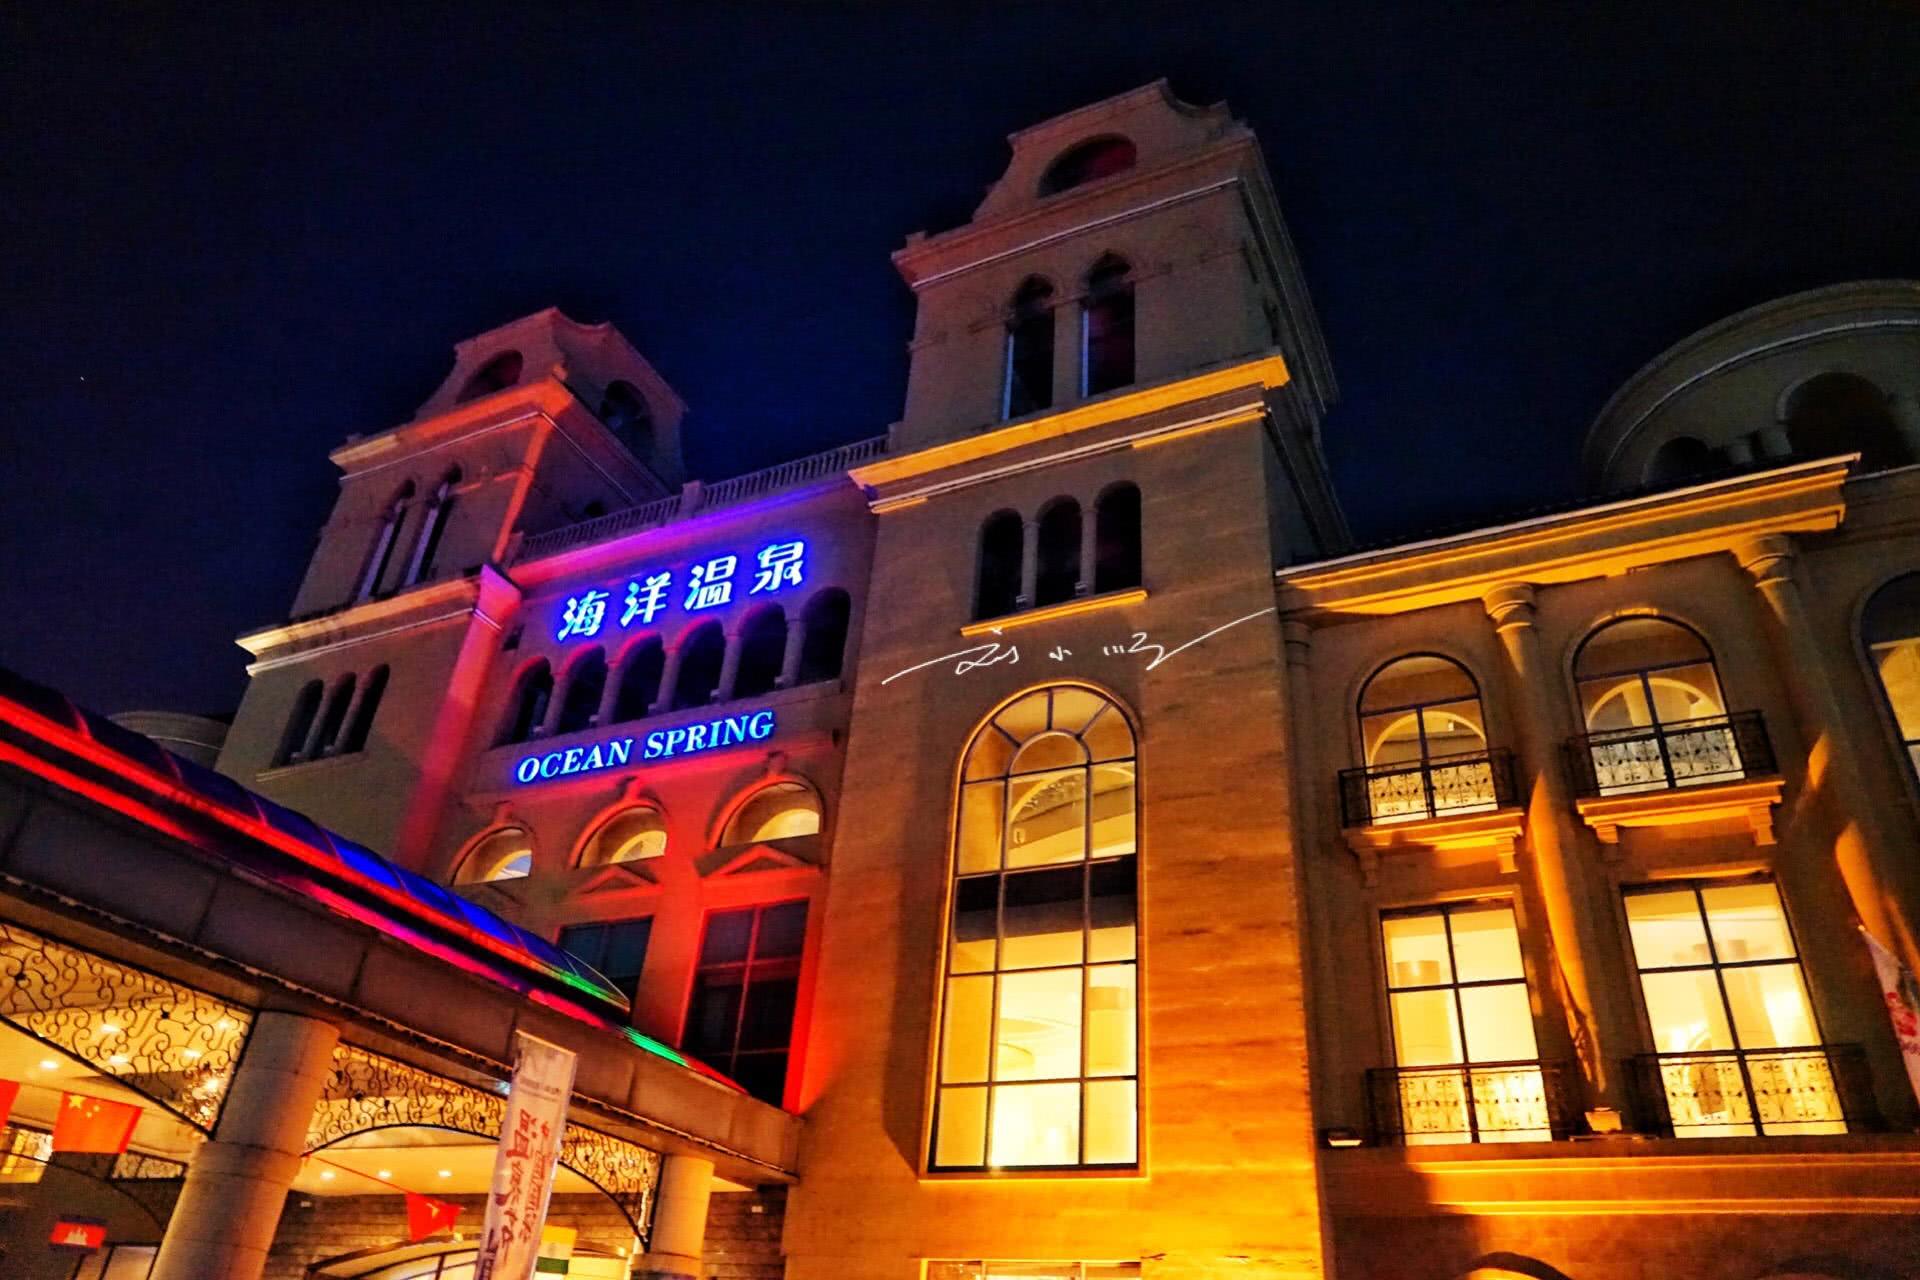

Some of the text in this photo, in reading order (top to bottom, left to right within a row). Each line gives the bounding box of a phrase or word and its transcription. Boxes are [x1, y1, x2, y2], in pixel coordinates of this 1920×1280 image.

[557, 541, 804, 640] 海洋温泉
[517, 711, 774, 783] OCEAN SPRING
